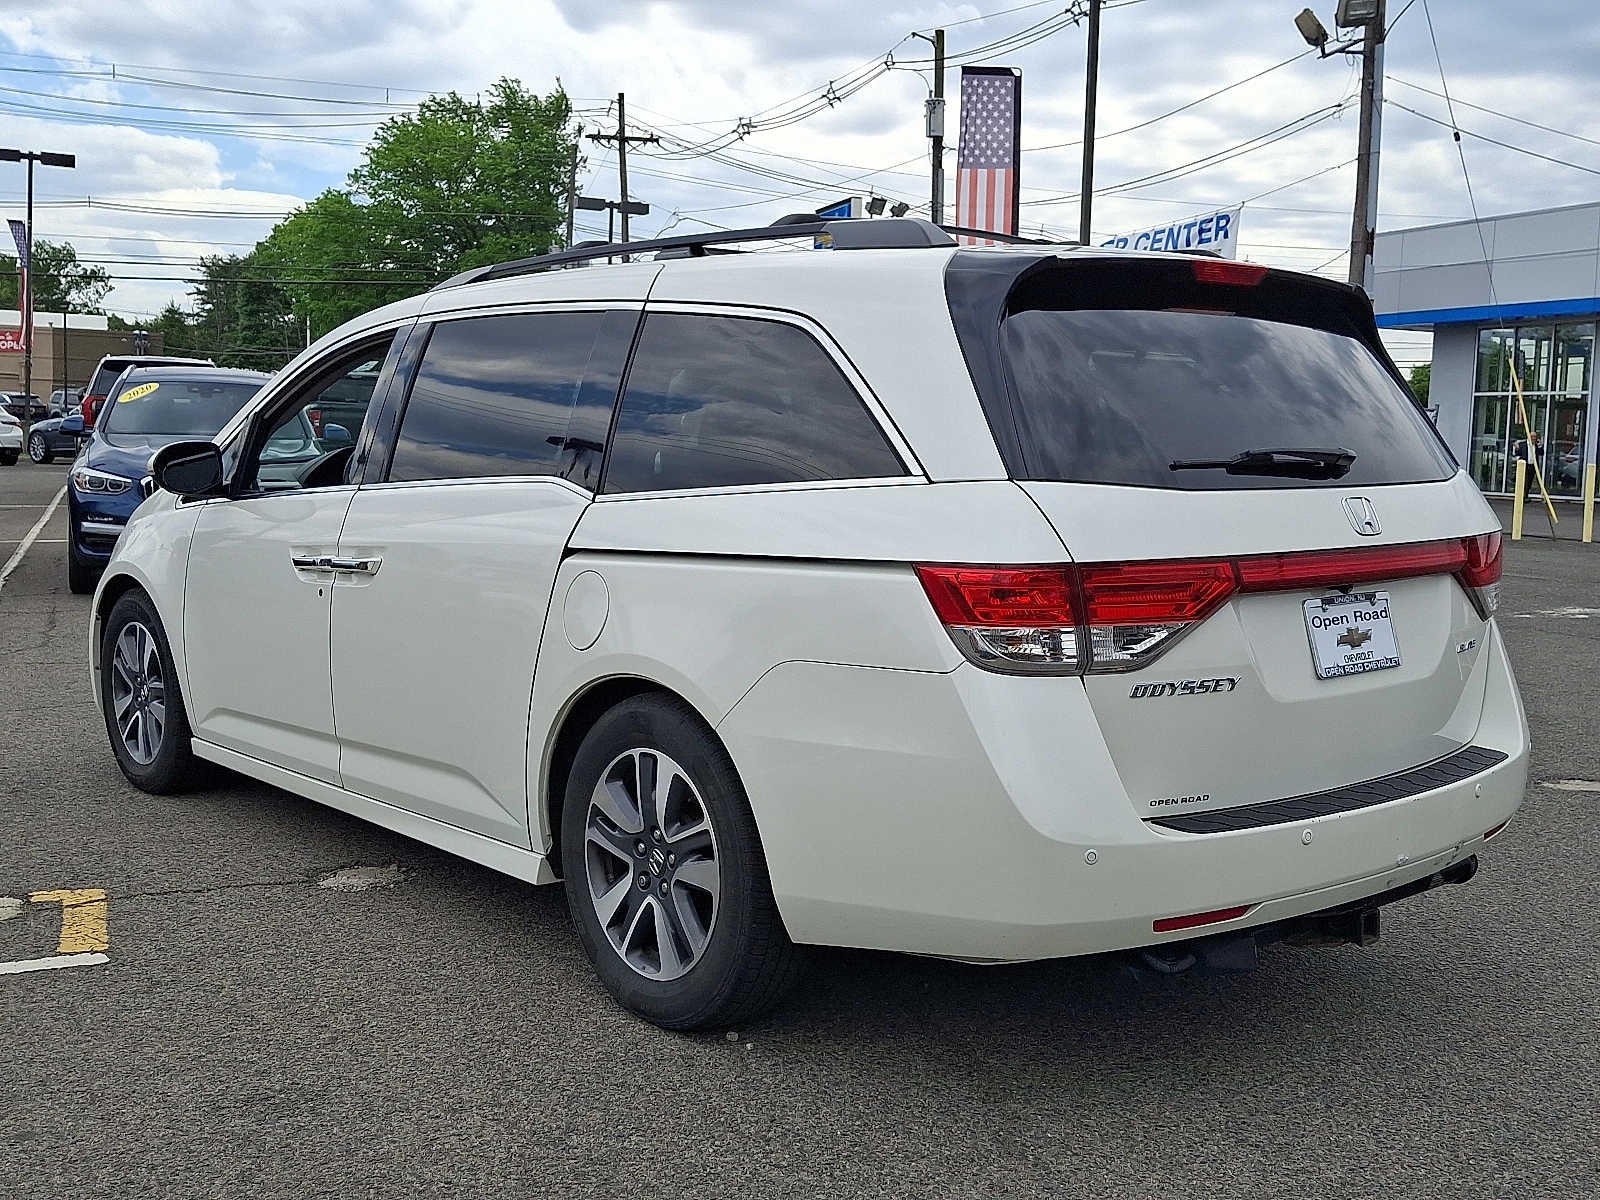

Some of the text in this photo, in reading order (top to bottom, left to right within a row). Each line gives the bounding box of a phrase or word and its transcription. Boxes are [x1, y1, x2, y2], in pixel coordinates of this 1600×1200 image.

[1134, 214, 1231, 251] CENTER
[127, 384, 152, 400] 2020
[1311, 606, 1388, 630] Open Road
[1325, 658, 1400, 677] OPEN ROAD CHEVROLET
[1129, 675, 1242, 699] ODYSSEY
[1149, 794, 1210, 807] OPEN ROAD
